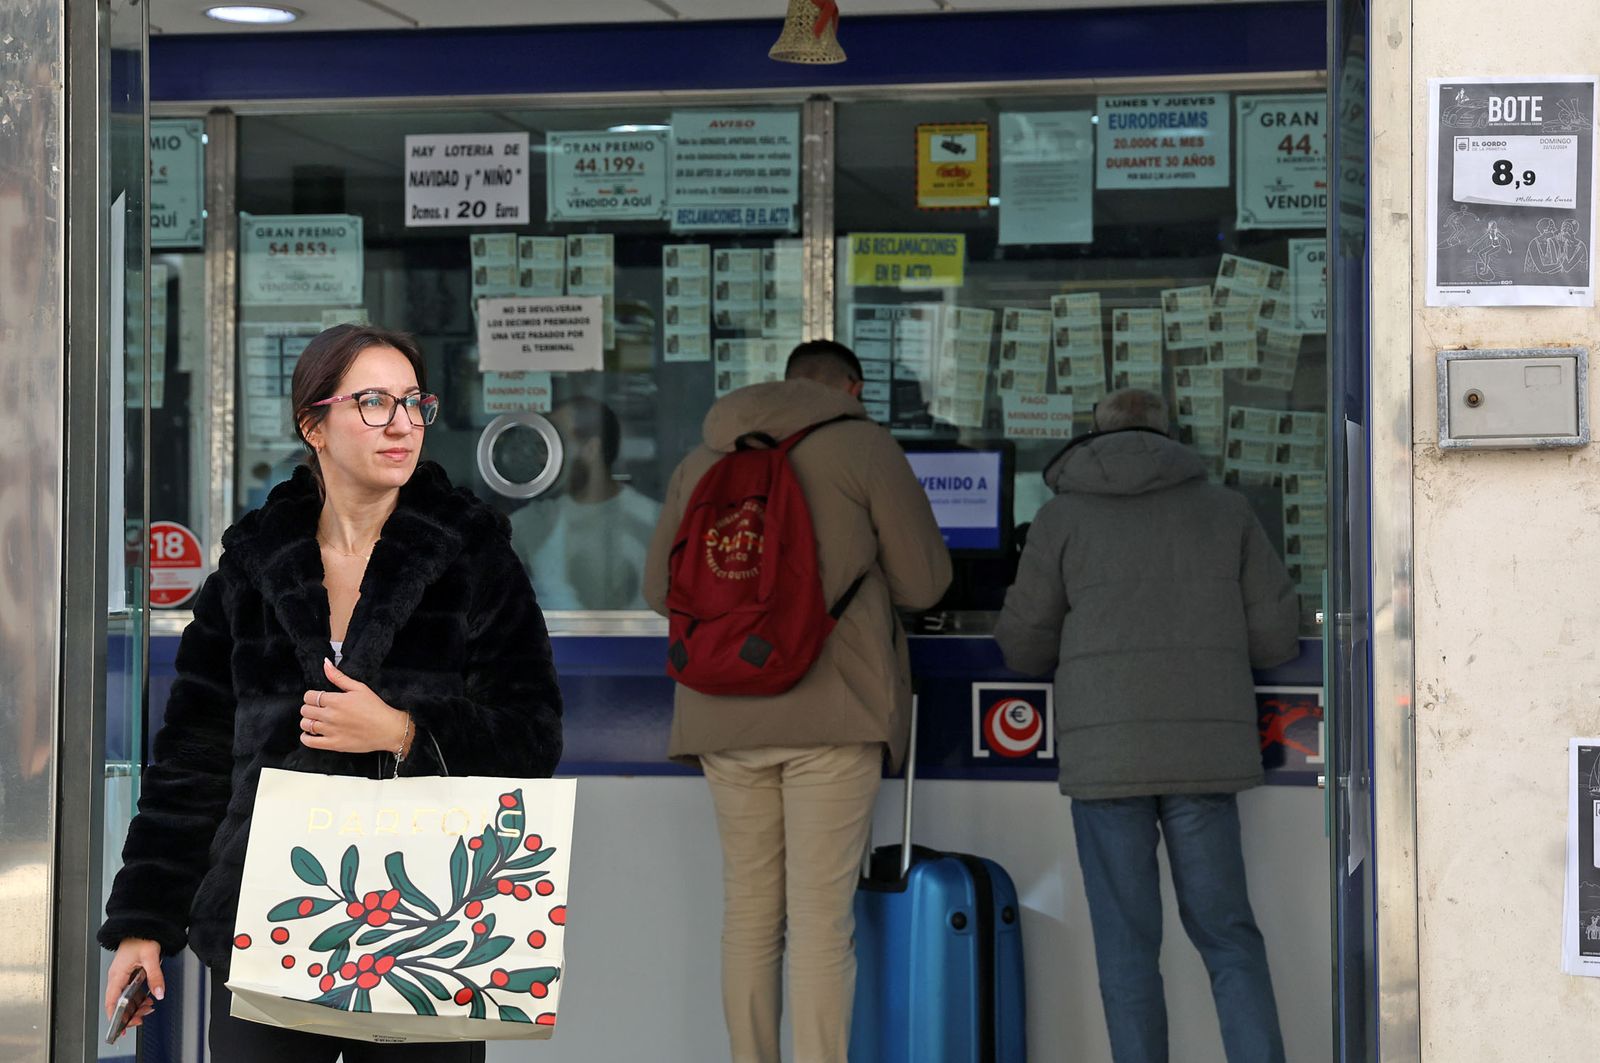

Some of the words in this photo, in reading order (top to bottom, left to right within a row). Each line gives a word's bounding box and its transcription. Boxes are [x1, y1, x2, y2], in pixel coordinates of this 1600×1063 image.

[1104, 98, 1148, 108] LUNES
[1152, 98, 1161, 106] Y
[1164, 97, 1216, 106] JUEVES
[1488, 95, 1543, 122] BOTE
[709, 119, 757, 129] AVISO
[1108, 111, 1209, 130] EURODREAMS
[1260, 111, 1319, 127] GRAN
[150, 135, 181, 150] MIO
[411, 145, 435, 157] HAY
[445, 144, 494, 157] LOTERIA
[504, 143, 520, 156] DE
[563, 142, 601, 154] GRAN
[605, 140, 655, 152] PREMIO
[1113, 137, 1157, 149] 20.000€
[1161, 136, 1176, 148] AL
[1179, 136, 1205, 147] MES
[575, 156, 636, 173] 44.199
[1106, 155, 1161, 169] DURANTE
[1165, 155, 1180, 168] 30
[1182, 153, 1216, 167] AÑOS
[409, 169, 459, 187] NAVIDAD
[465, 174, 472, 191] y
[1491, 159, 1536, 190] 8,9
[457, 200, 487, 218] 20
[567, 197, 618, 208] VENDIDO
[1264, 194, 1327, 209] VENDID
[150, 210, 177, 228] QUÍ
[256, 226, 294, 239] GRAN
[298, 226, 346, 238] PREMIO
[873, 237, 957, 255] RECLAMACIONES
[1307, 250, 1326, 263] GR
[502, 305, 515, 314] NO
[517, 305, 527, 313] SE
[529, 303, 583, 313] DEVOLVERAN
[487, 319, 503, 328] LOS
[505, 318, 541, 327] DECIMOS
[543, 316, 591, 326] PREMIADOS
[491, 332, 509, 341] UNA
[511, 331, 526, 340] VEZ
[528, 330, 565, 339] PASADOS
[567, 329, 584, 338] POR
[521, 343, 531, 353] EL
[534, 343, 575, 352] TERMINAL
[918, 476, 973, 491] VENIDO
[977, 476, 988, 490] A
[150, 531, 185, 560] 18
